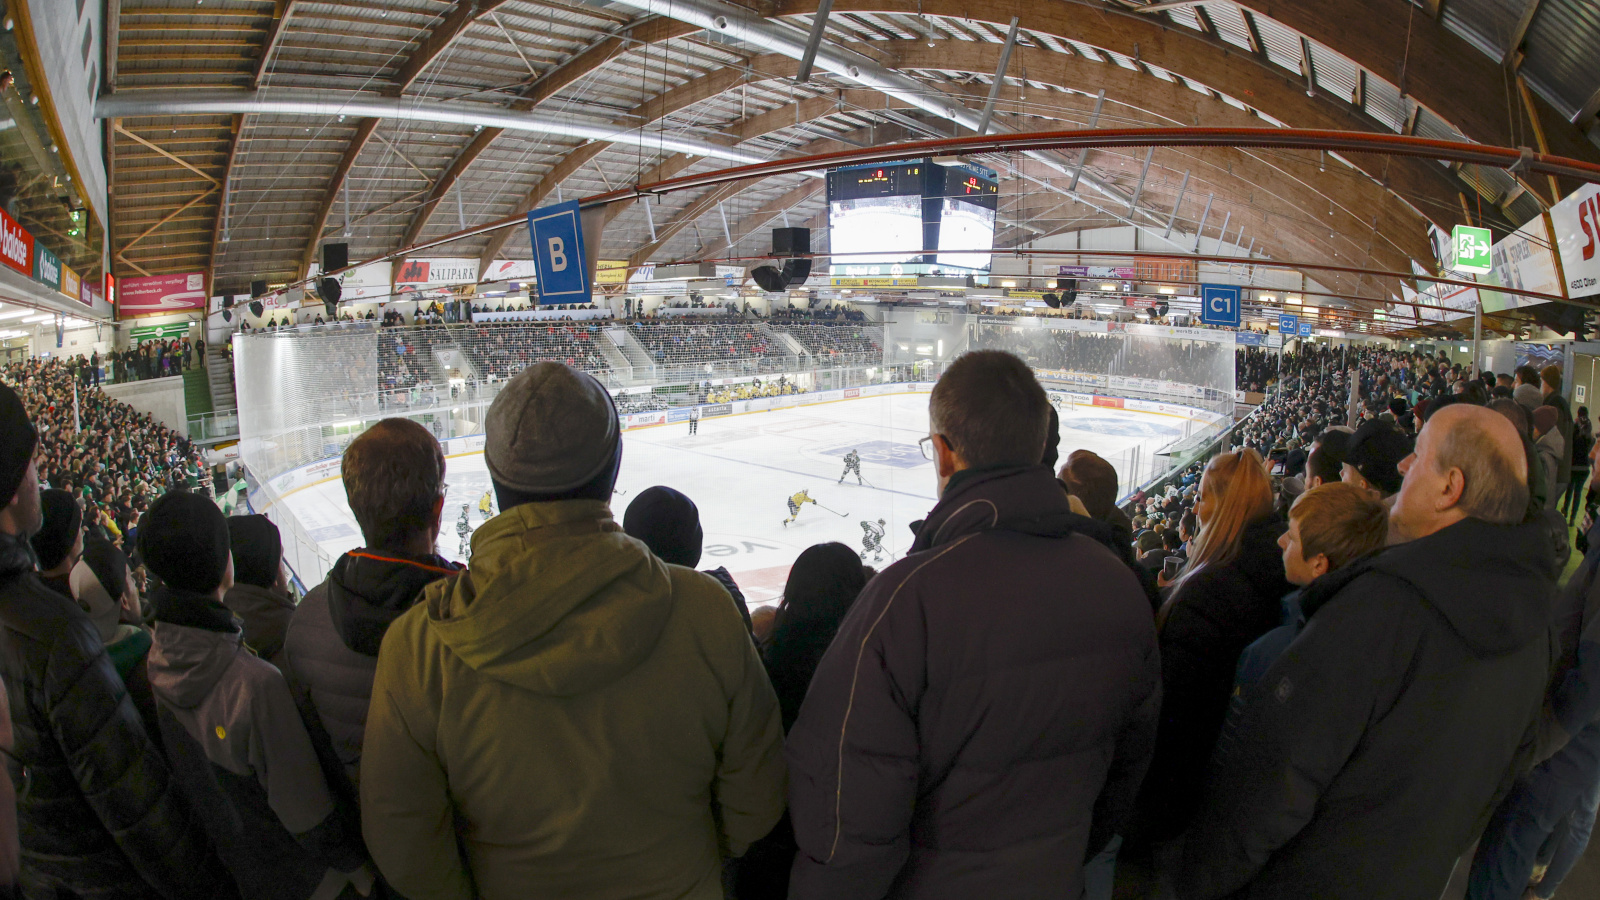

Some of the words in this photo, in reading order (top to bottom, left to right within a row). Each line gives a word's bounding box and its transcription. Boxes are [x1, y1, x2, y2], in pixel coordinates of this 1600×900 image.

[548, 236, 568, 273] B
[430, 267, 475, 281] SALIPARK
[1210, 297, 1231, 313] C1
[1281, 320, 1294, 329] C2
[638, 414, 656, 423] marti
